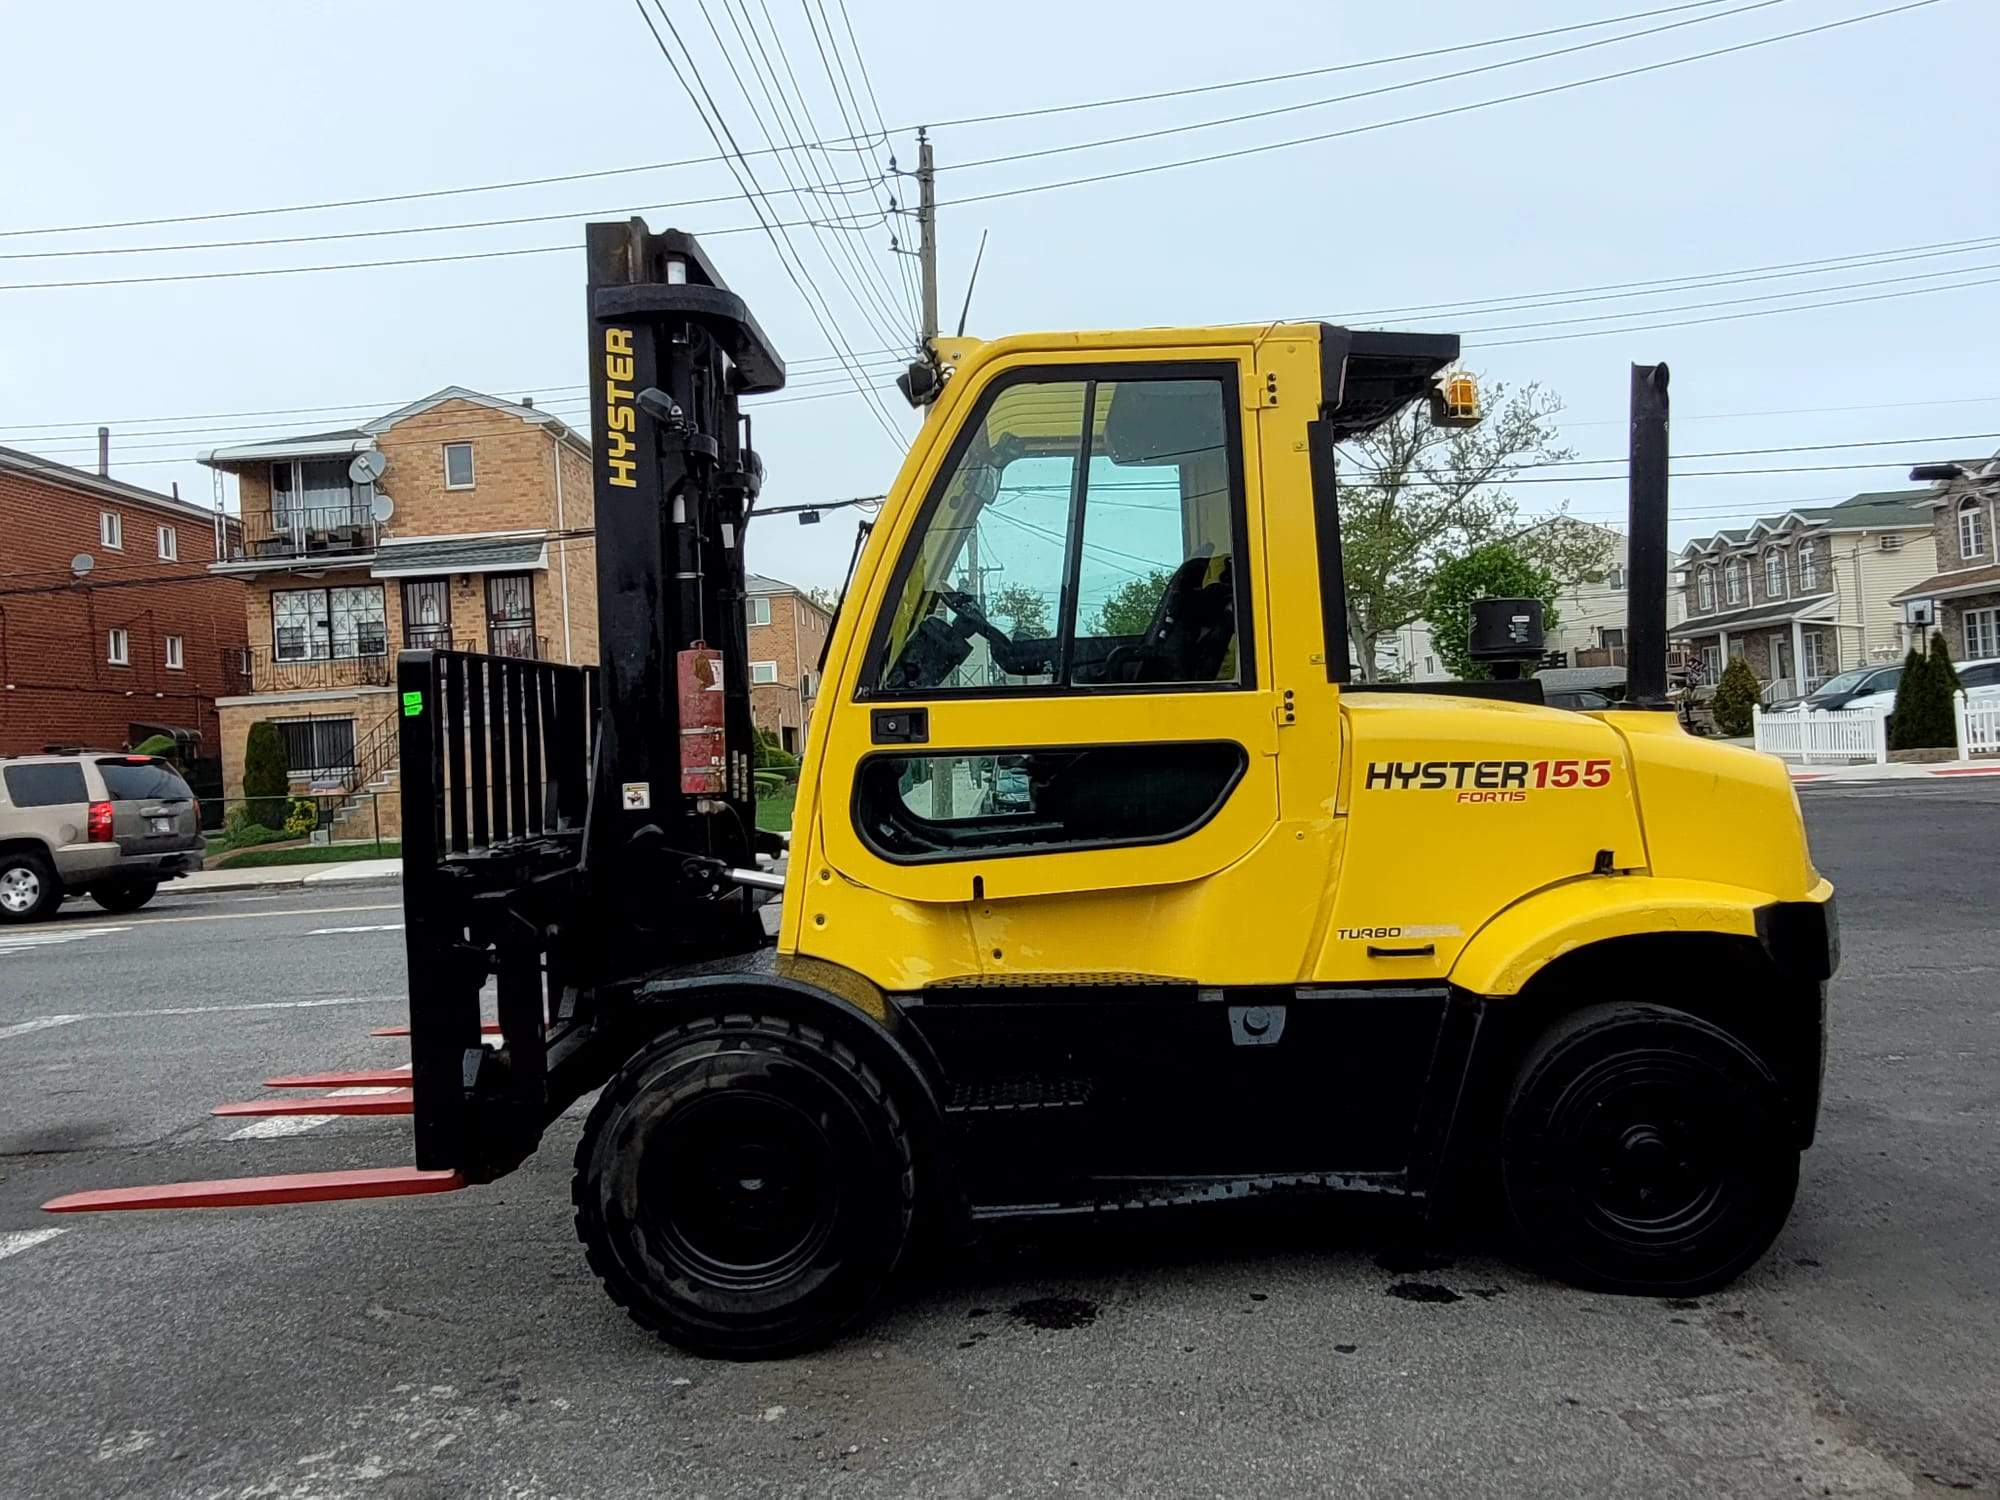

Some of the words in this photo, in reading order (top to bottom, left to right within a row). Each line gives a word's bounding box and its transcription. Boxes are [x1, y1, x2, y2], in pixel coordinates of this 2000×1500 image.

[606, 328, 637, 488] HYSTER
[1457, 791, 1526, 803] FORTIS
[1337, 927, 1401, 939] TURBO
